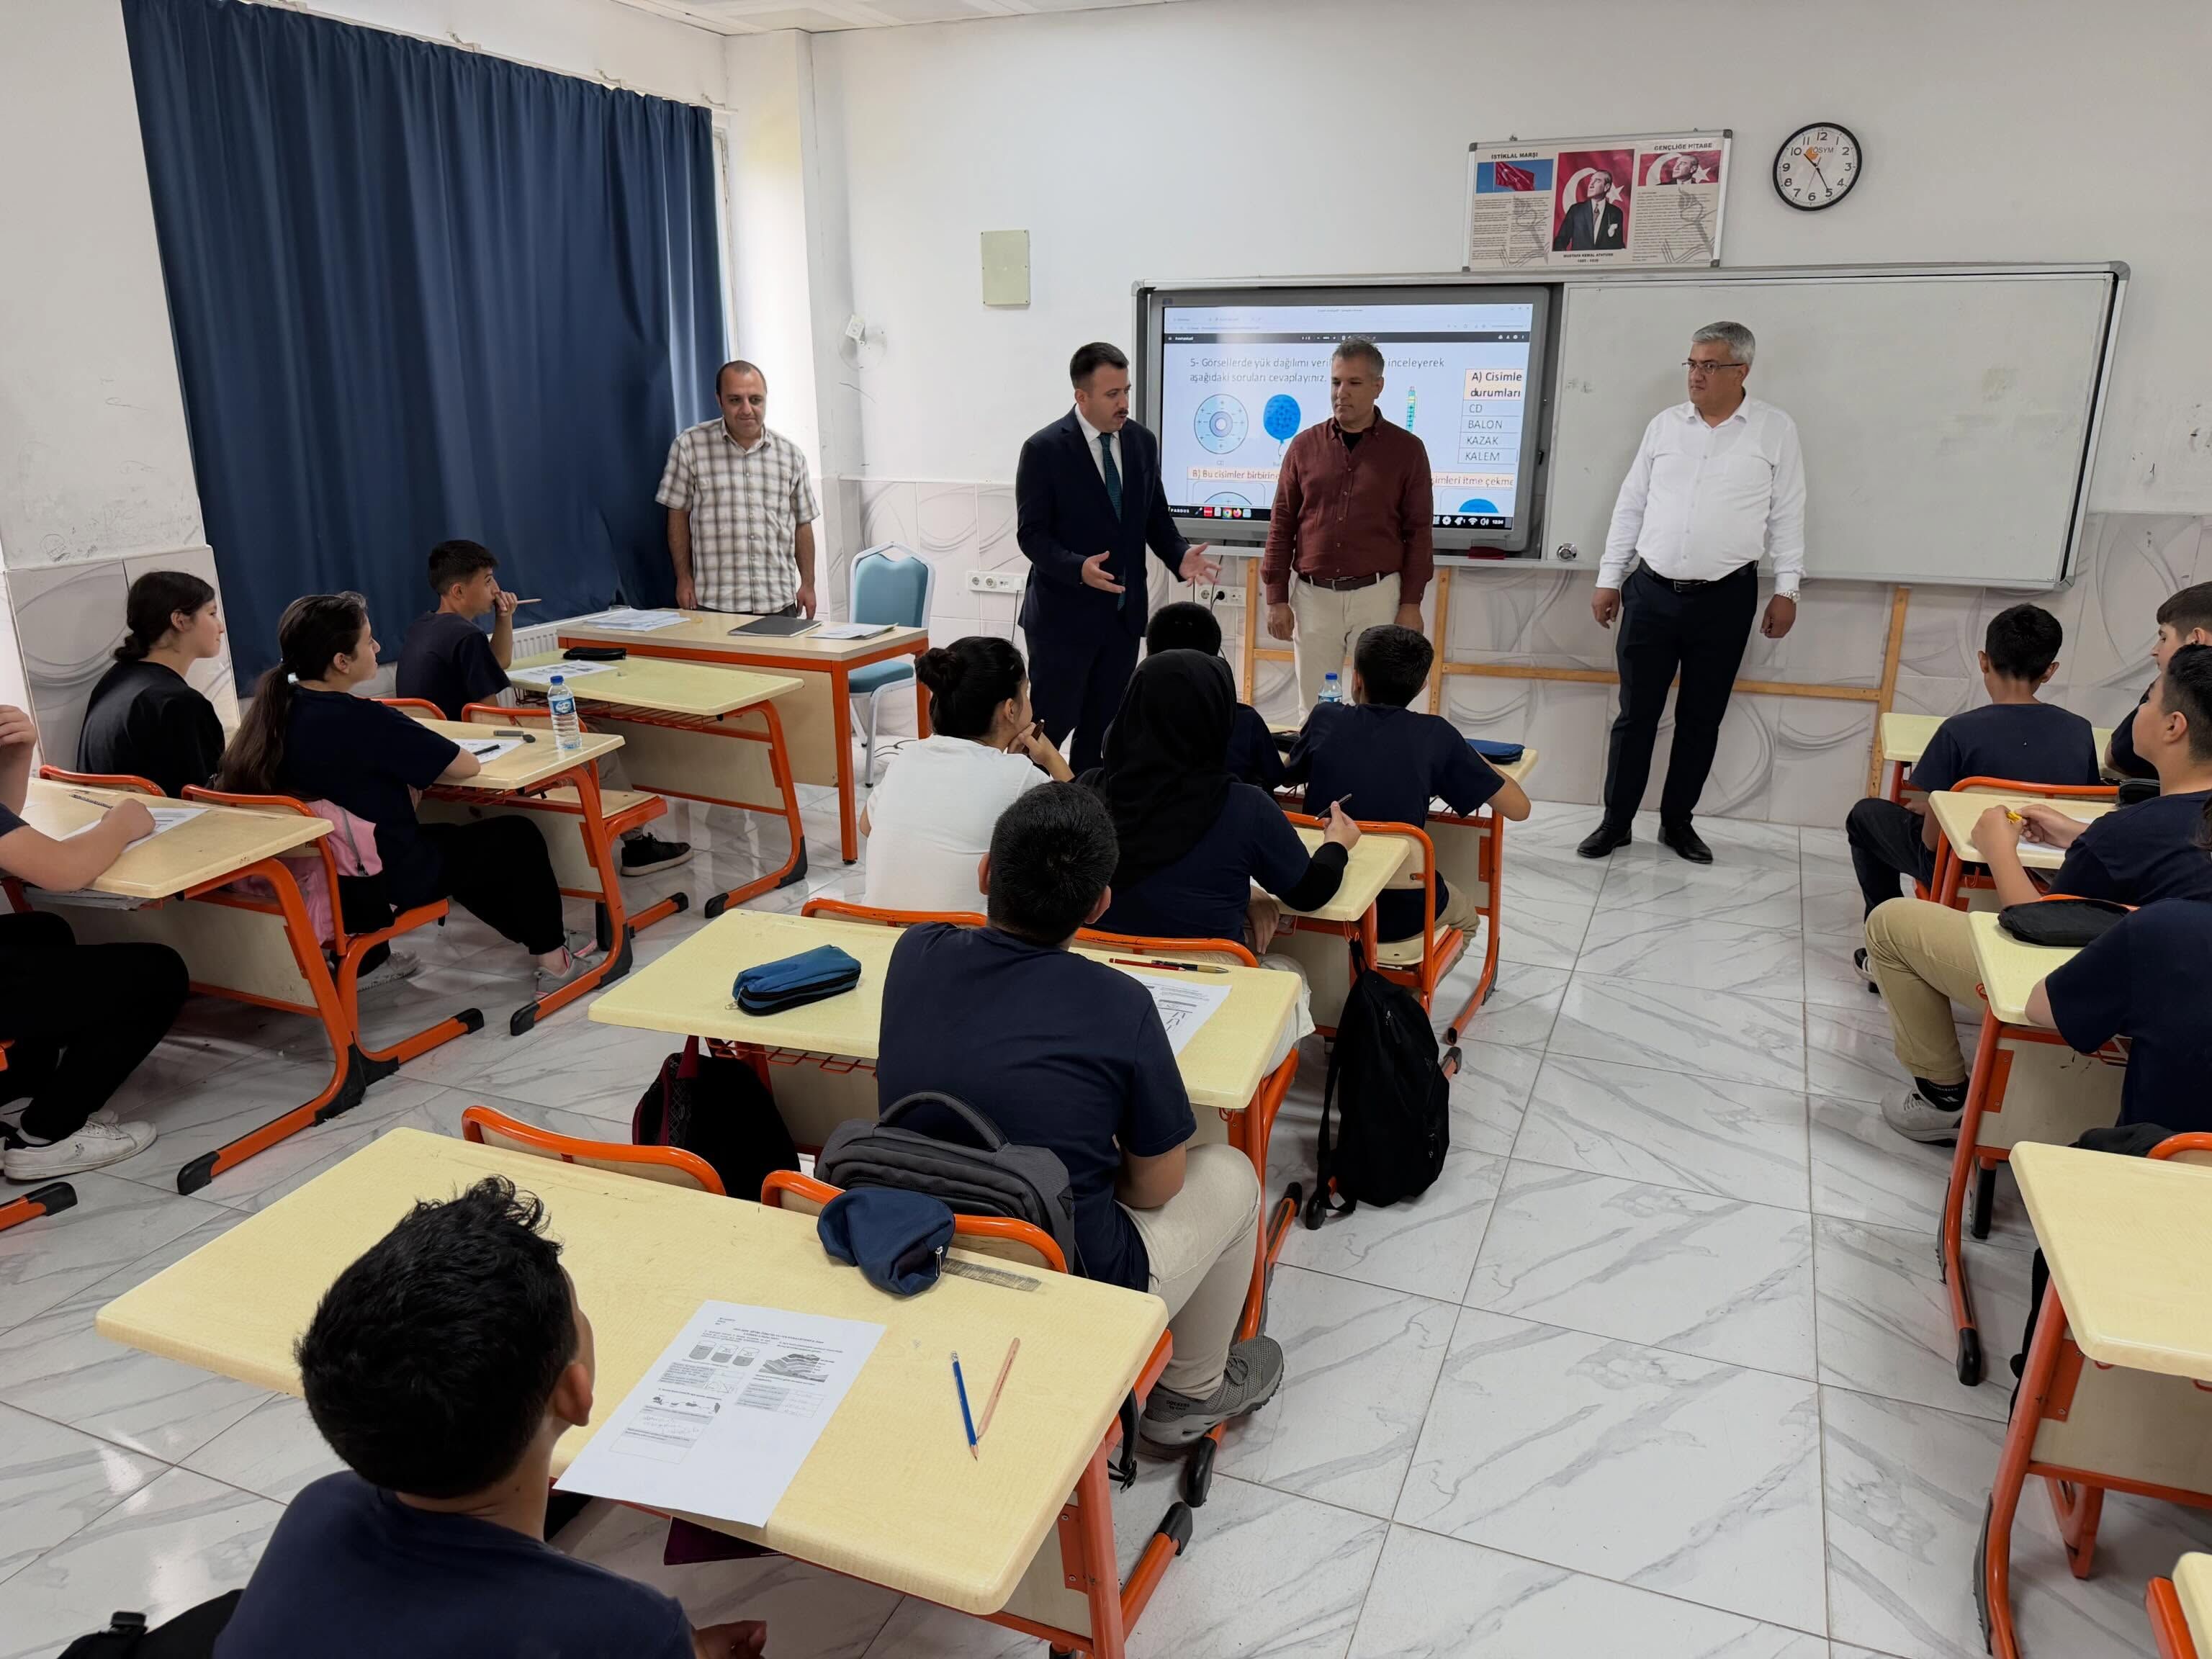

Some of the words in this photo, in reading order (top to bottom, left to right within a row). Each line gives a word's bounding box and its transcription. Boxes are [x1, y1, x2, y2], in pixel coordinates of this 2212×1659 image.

[1803, 136, 1809, 145] 11
[1817, 132, 1827, 140] 12
[1835, 136, 1839, 145] 1
[1791, 147, 1802, 156] 10
[1842, 147, 1850, 156] 2
[1782, 163, 1791, 172] 9
[1845, 163, 1852, 171] 3
[1784, 178, 1792, 187] 8
[1837, 179, 1844, 187] 4
[1794, 189, 1801, 197] 7
[1808, 192, 1816, 201] 6
[1825, 188, 1833, 197] 5
[1202, 357, 1251, 367] Görsellerde
[1254, 357, 1270, 370] yük
[1274, 357, 1308, 369] dağılımı
[1388, 358, 1444, 369] inceleyerek
[1190, 372, 1229, 383] aşağıdaki
[1232, 373, 1266, 382] soruları
[1269, 373, 1327, 383] cevaplayınız.
[1472, 372, 1482, 382] A)
[1485, 372, 1522, 382] Cisimle
[1470, 388, 1521, 397] durumları
[1469, 404, 1483, 413] CD
[1468, 421, 1503, 429] BALON
[1467, 436, 1498, 445] KAZAK
[1465, 452, 1500, 461] KALEM
[1215, 470, 1244, 479] cisimler
